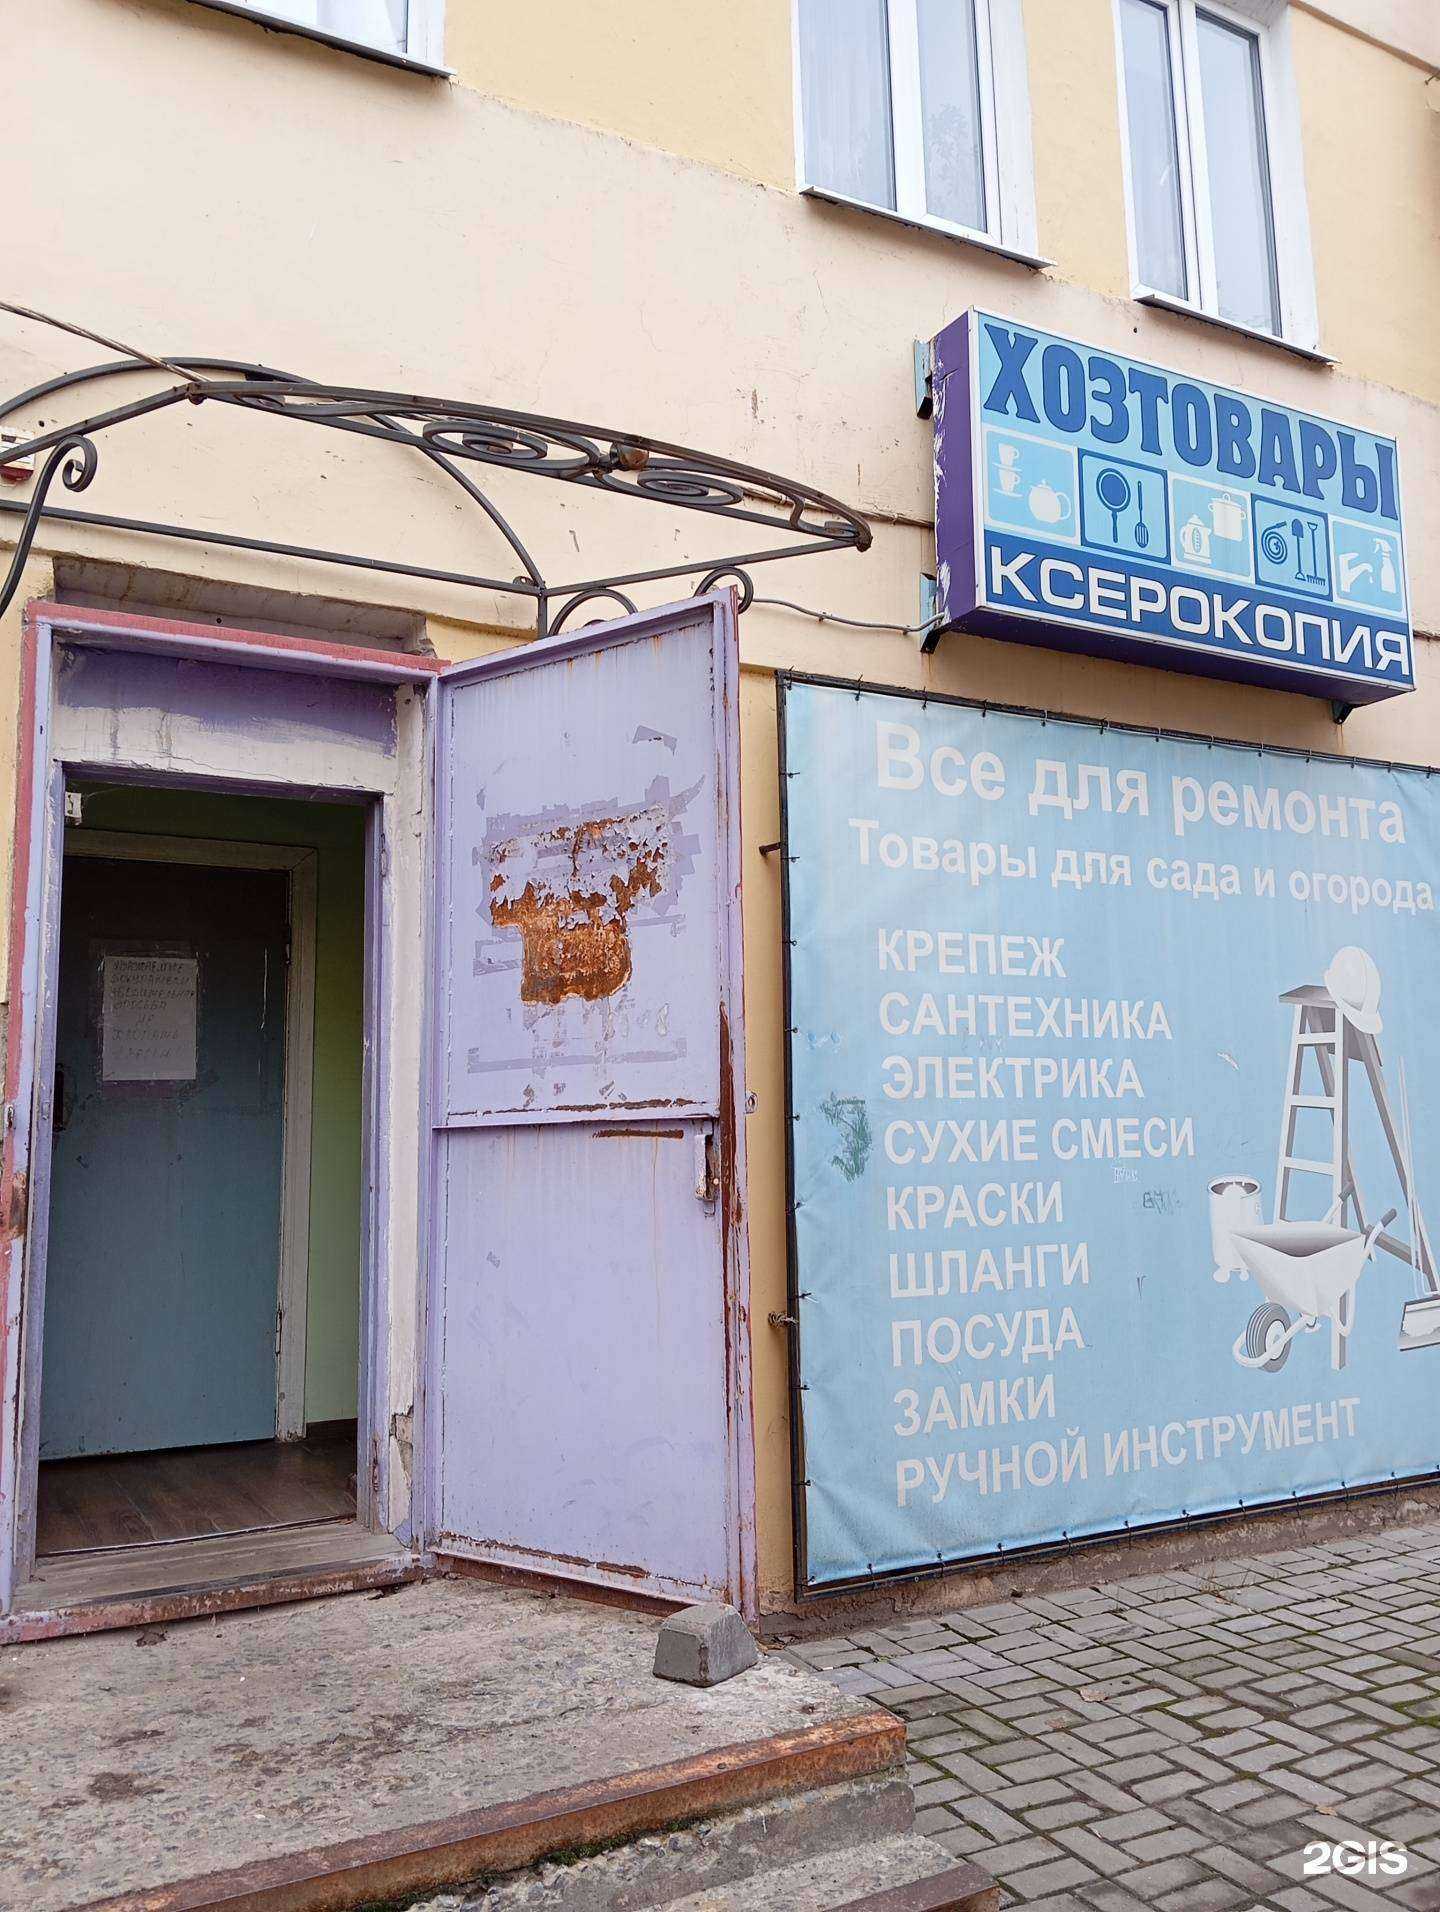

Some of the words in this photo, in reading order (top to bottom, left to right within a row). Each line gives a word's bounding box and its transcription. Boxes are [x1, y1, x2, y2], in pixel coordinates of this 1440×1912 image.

[983, 323, 1399, 520] ХОЗТОВАРЫ
[990, 546, 1411, 676] КСЕРОКОПИЯ
[875, 720, 1006, 801] Все
[1029, 759, 1150, 819] для
[1172, 776, 1406, 844] ремонта
[848, 818, 1037, 885] Товары
[1051, 849, 1132, 890] для
[1147, 858, 1241, 900] сада
[1255, 866, 1275, 897] и
[1289, 869, 1435, 914] огорода
[877, 928, 1067, 978] КРЕПЕЖ
[879, 992, 1172, 1039] САНТЕХНИКА
[882, 1055, 1144, 1099] ЭЛЕКТРИКА
[884, 1119, 1038, 1166] СУХИЕ
[1052, 1117, 1195, 1160] СМЕСИ
[887, 1181, 1063, 1230] КРАСКИ
[890, 1242, 1090, 1299] ШЛАНГИ
[891, 1307, 1085, 1367] ПОСУДА
[893, 1374, 1055, 1436] ЗАМКИ
[897, 1428, 1088, 1508] РУЧНОЙ
[1104, 1398, 1360, 1476] ИНСТРУМЕНТ
